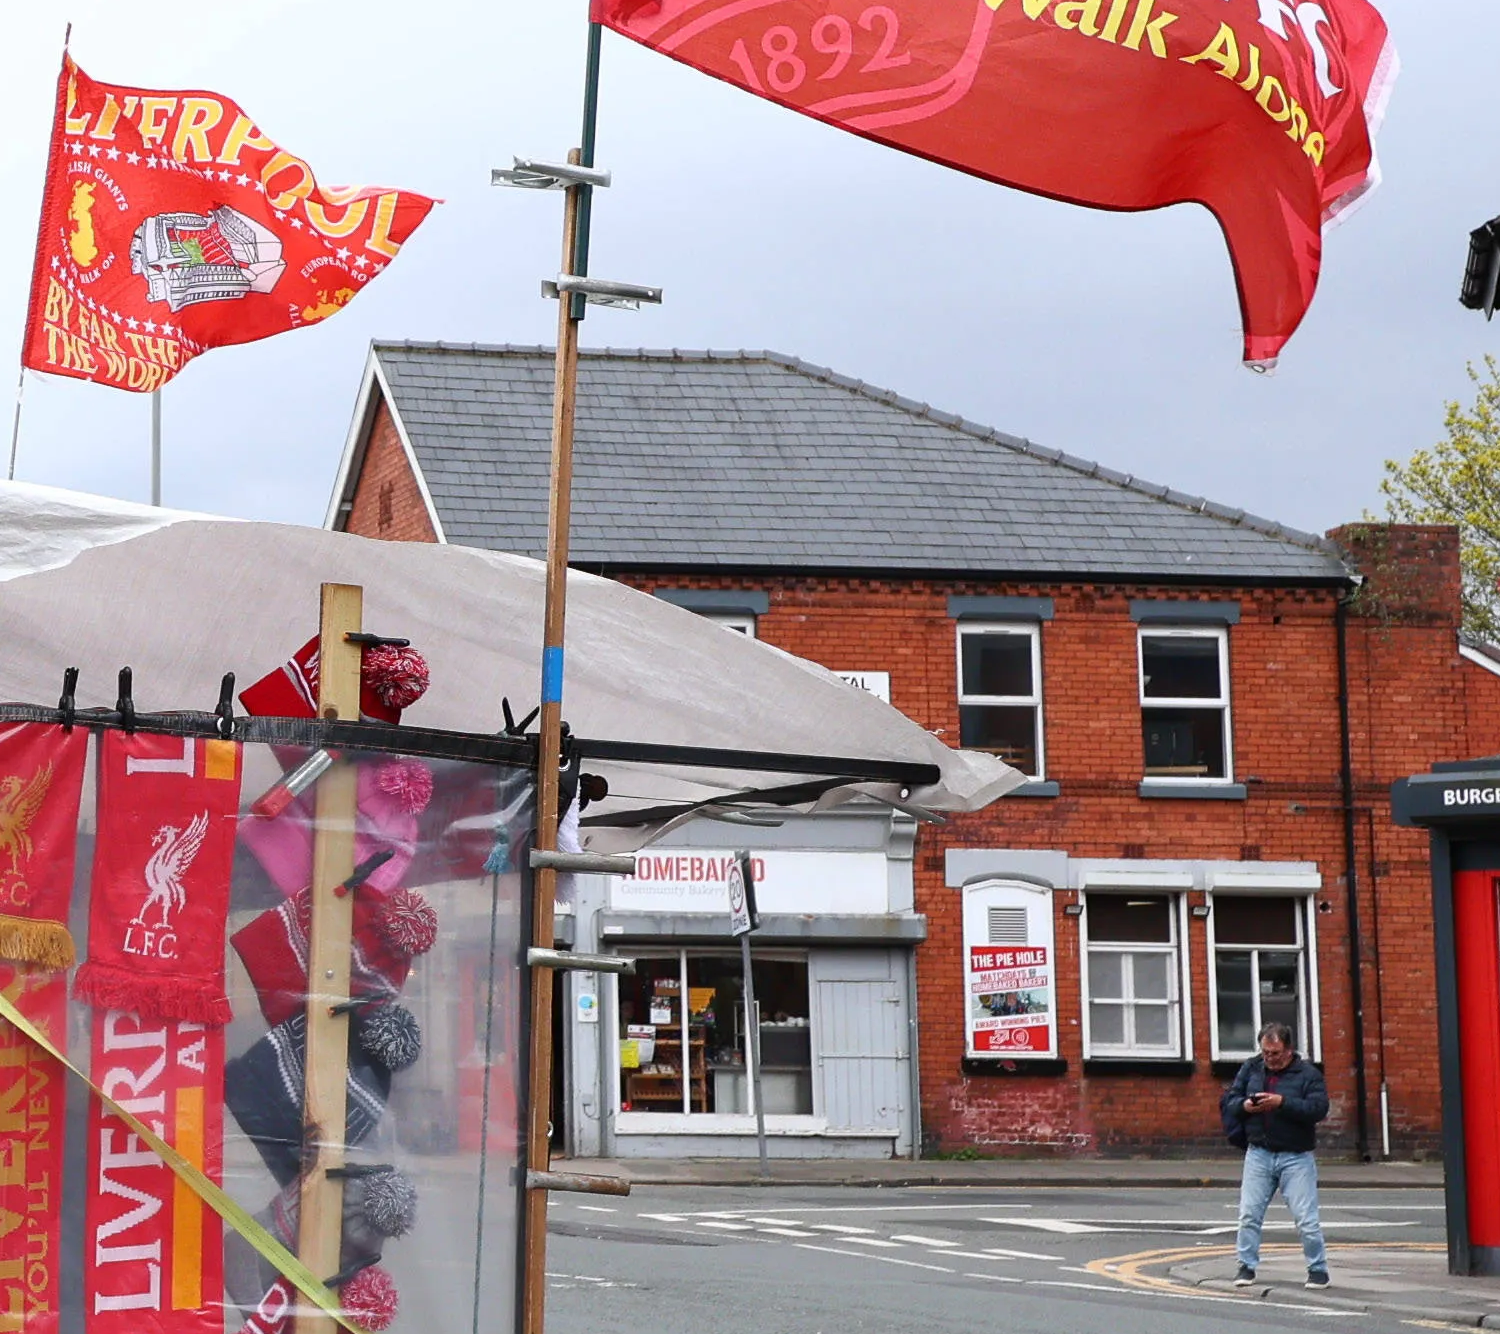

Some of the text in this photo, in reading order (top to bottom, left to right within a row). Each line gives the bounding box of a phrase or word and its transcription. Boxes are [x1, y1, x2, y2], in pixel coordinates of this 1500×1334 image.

[730, 4, 912, 93] 1892
[94, 168, 129, 212] GIANTS
[43, 275, 74, 324] BY
[79, 304, 119, 353] FAR
[123, 330, 181, 371] THE
[43, 321, 98, 374] THE
[621, 885, 725, 897] Community Bakery
[123, 927, 180, 960] L.F.C.
[972, 950, 1044, 969] THE PIE HOLE
[94, 1009, 168, 1316] LIVERP
[27, 1171, 50, 1316] YOU'LL
